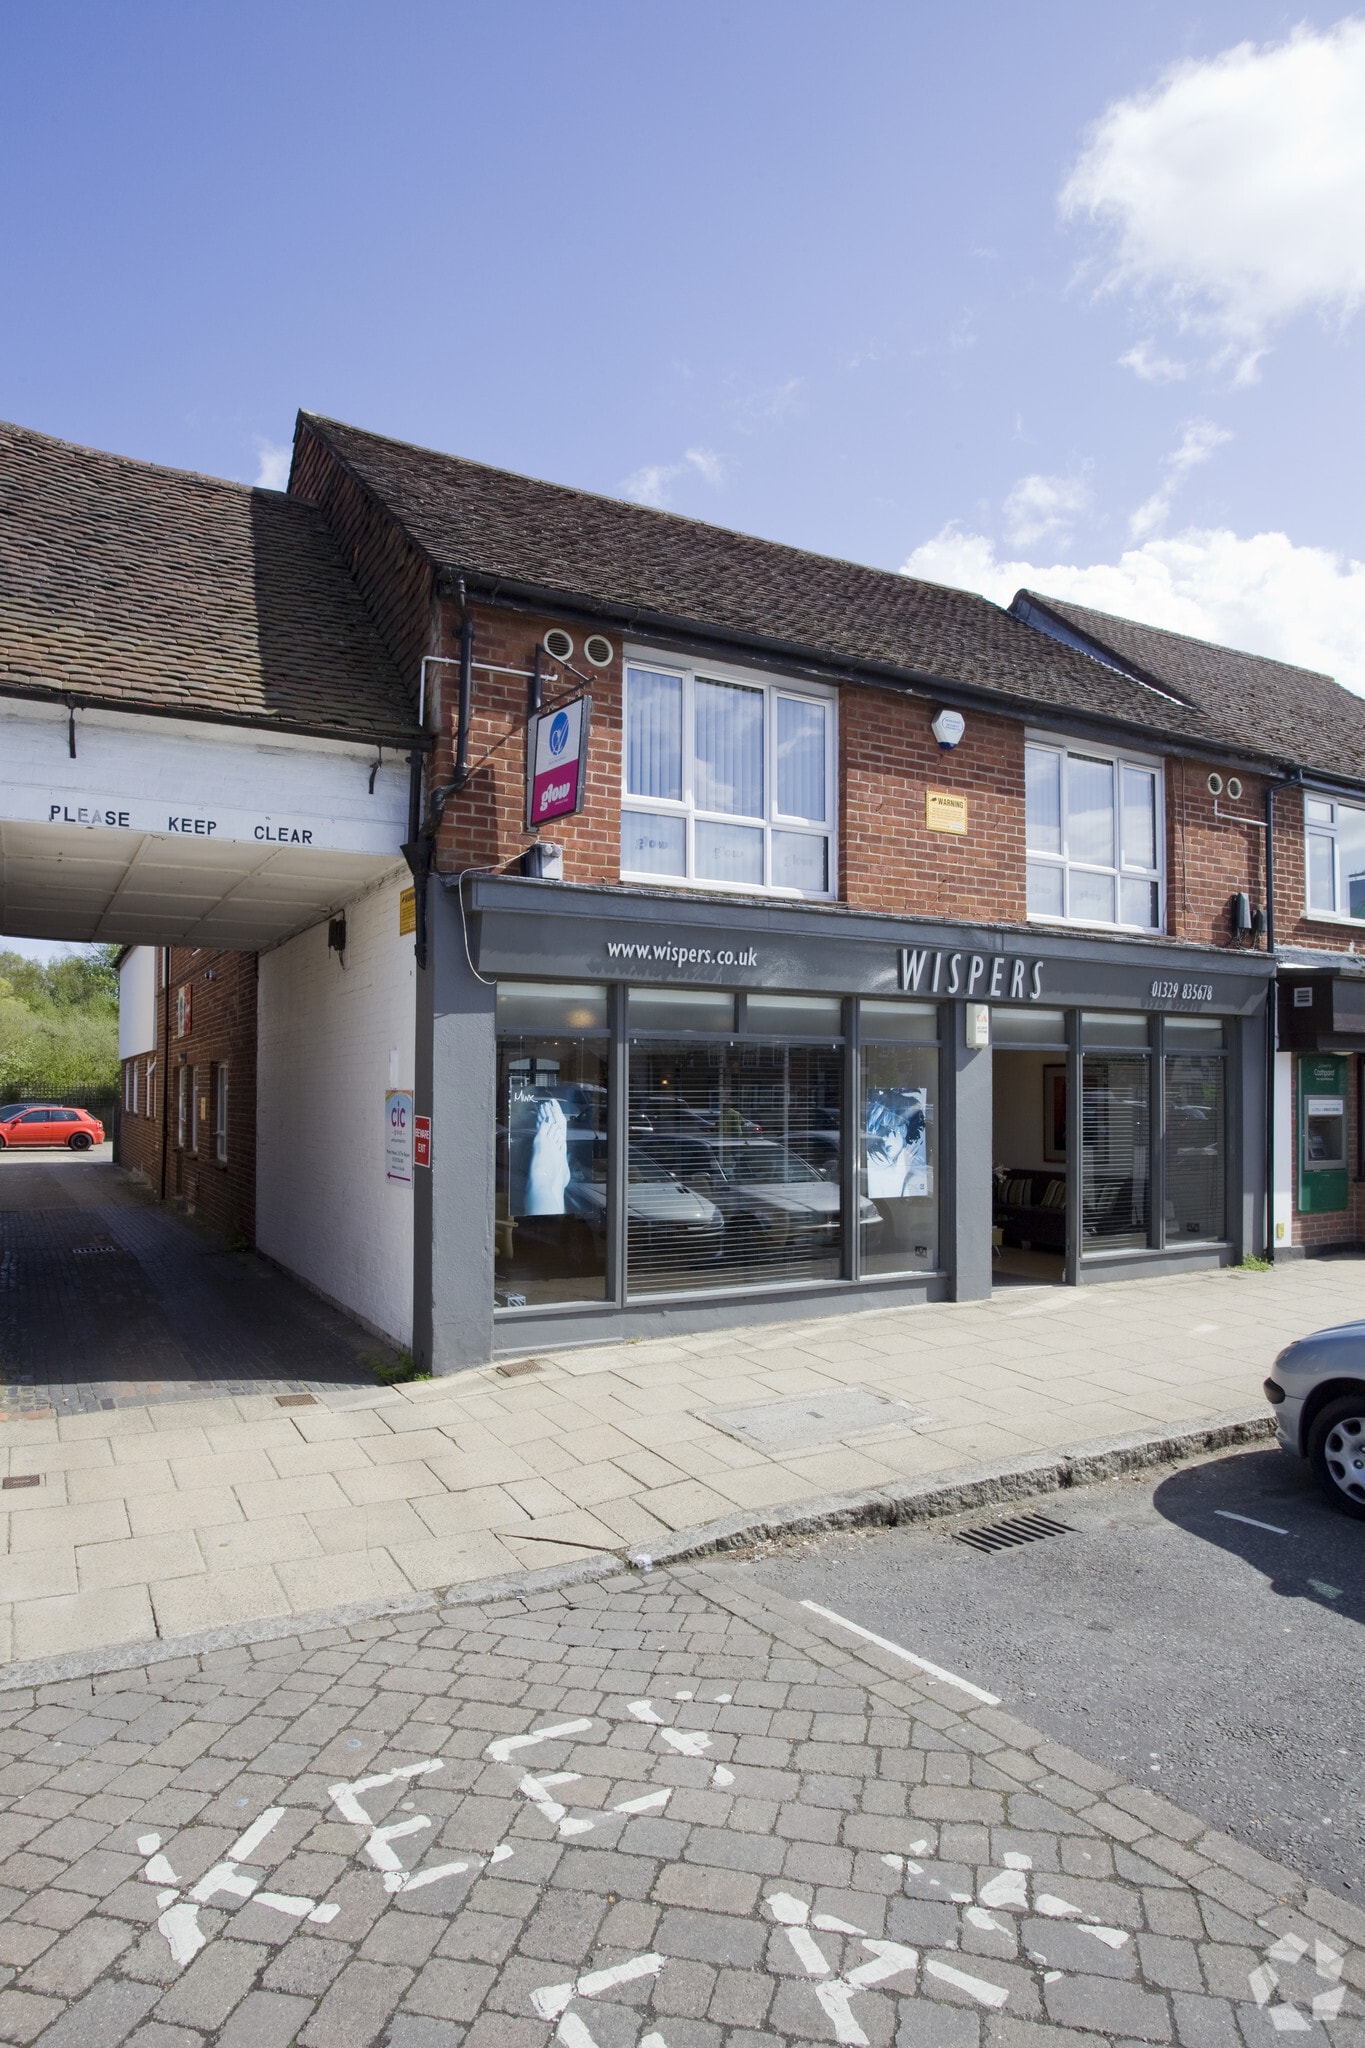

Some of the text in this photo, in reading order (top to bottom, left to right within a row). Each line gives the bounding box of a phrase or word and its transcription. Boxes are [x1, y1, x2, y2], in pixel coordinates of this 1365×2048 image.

[540, 782, 570, 812] glow
[938, 797, 964, 809] WARNING
[50, 804, 313, 844] PLEASE KEEP CLEAR
[607, 941, 758, 968] www.wispers.co.uk
[902, 949, 1043, 999] WISPERS
[1151, 981, 1213, 1001] 01329 835678
[391, 1101, 406, 1128] cic
[415, 1128, 430, 1140] BEWARE
[418, 1143, 427, 1153] EXIT
